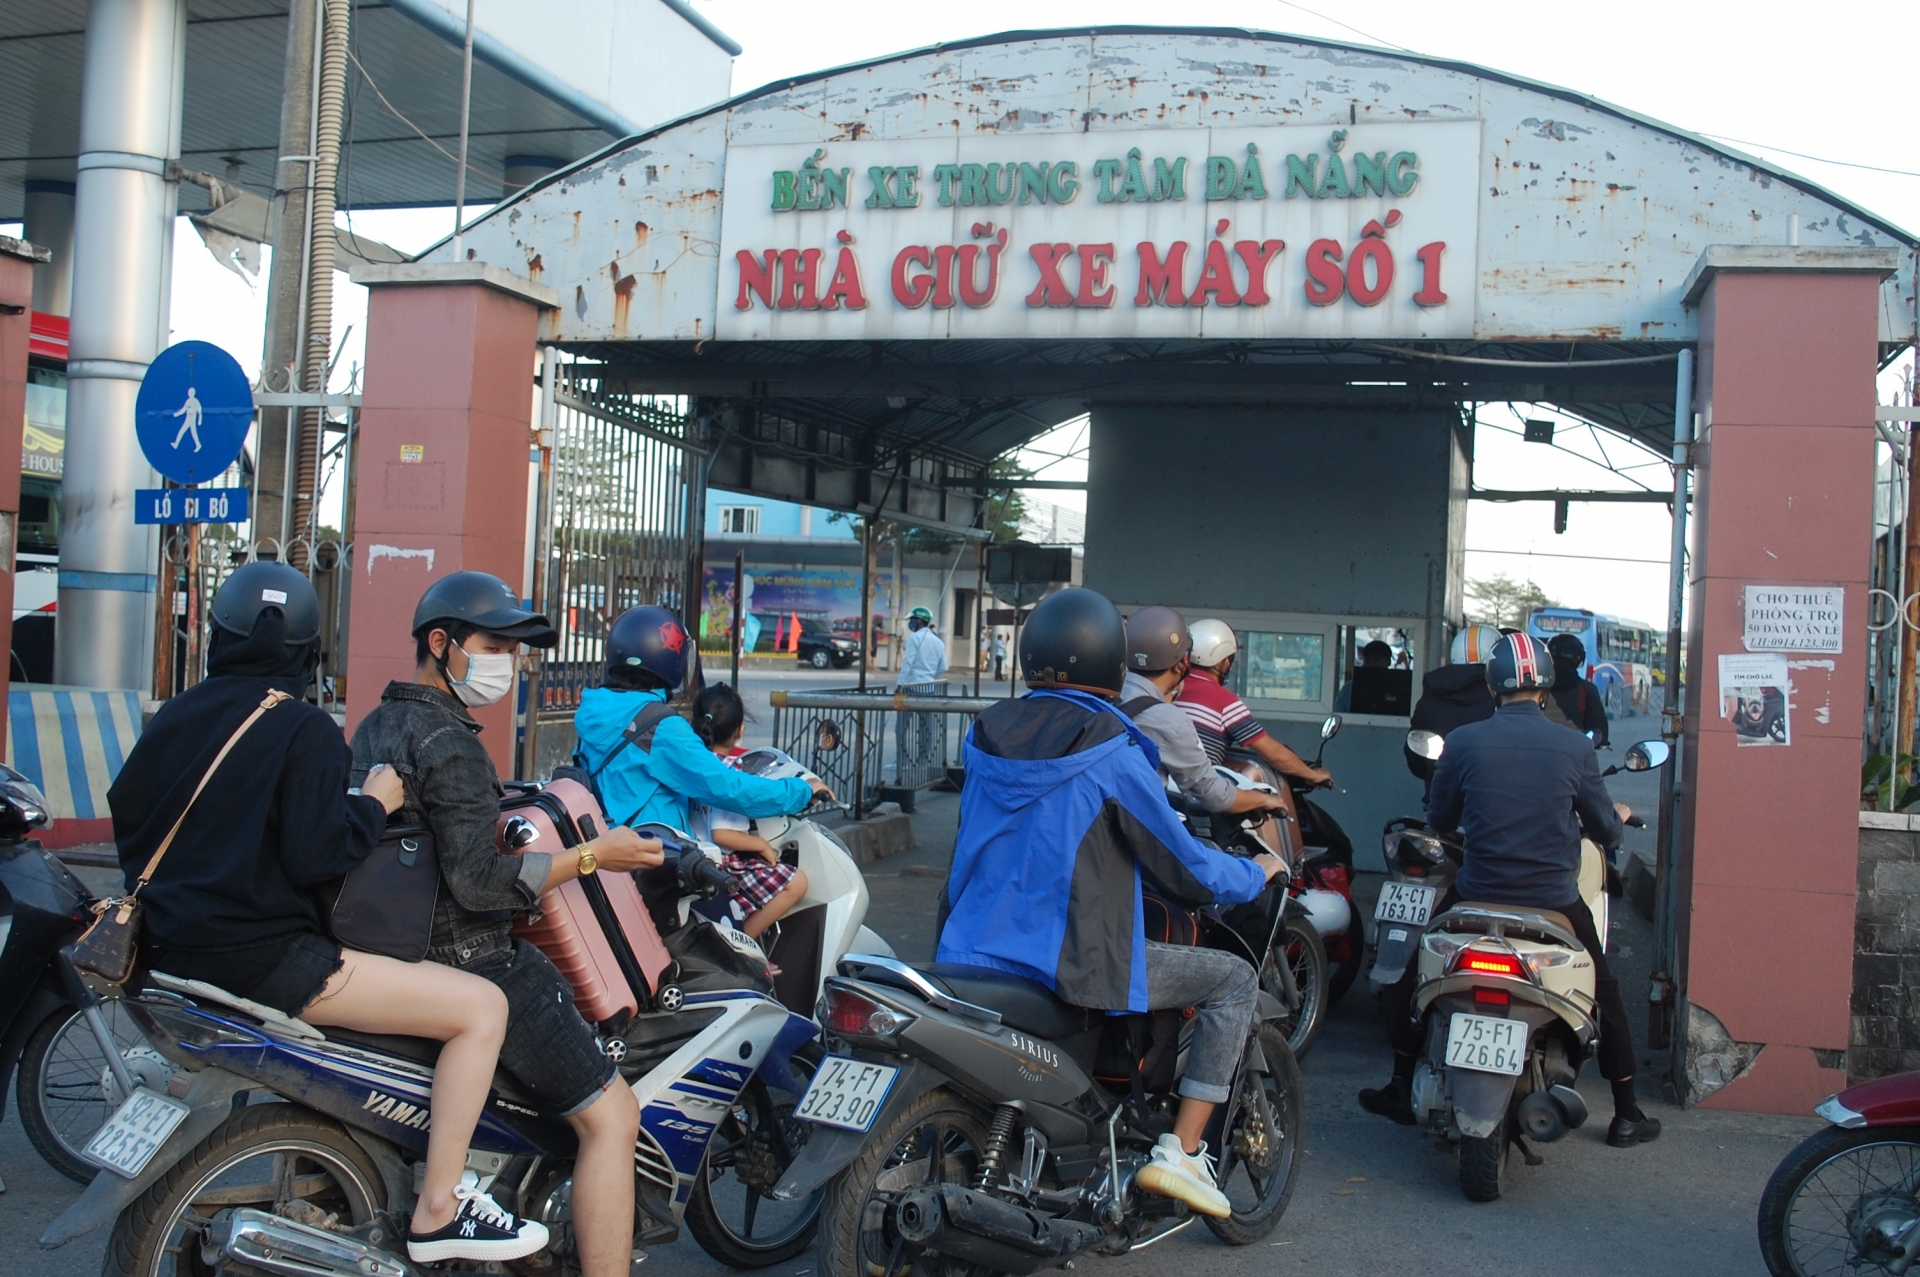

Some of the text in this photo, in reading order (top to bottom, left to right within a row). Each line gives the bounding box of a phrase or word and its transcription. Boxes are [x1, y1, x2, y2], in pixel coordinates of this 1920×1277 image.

[771, 148, 853, 211] BẾN
[864, 165, 922, 208] XE
[934, 160, 1080, 207] TRUNG
[1094, 147, 1189, 202] TÂM
[1205, 142, 1269, 201] ĐÀ
[734, 209, 1448, 311] NHÀ GIỮ XE MÁY SỐ 1
[1756, 591, 1834, 606] CHO THUÊ
[1747, 624, 1760, 634] 50
[1763, 622, 1792, 634] ĐÀM
[1795, 623, 1821, 635] VĂN
[1751, 606, 1838, 624] PHÒNG TRỌ
[1389, 885, 1426, 904] 74-C1
[1381, 901, 1427, 923] 163.18
[1461, 1018, 1513, 1045] 75-F1
[1011, 1033, 1059, 1068] SIRIUS
[1451, 1041, 1518, 1071] 726.64
[822, 1060, 883, 1094] 74-F1
[1018, 1065, 1043, 1082] SPECIAL
[122, 1095, 177, 1137] 92-E1
[800, 1088, 876, 1127] 323.90
[656, 1119, 712, 1135] 135
